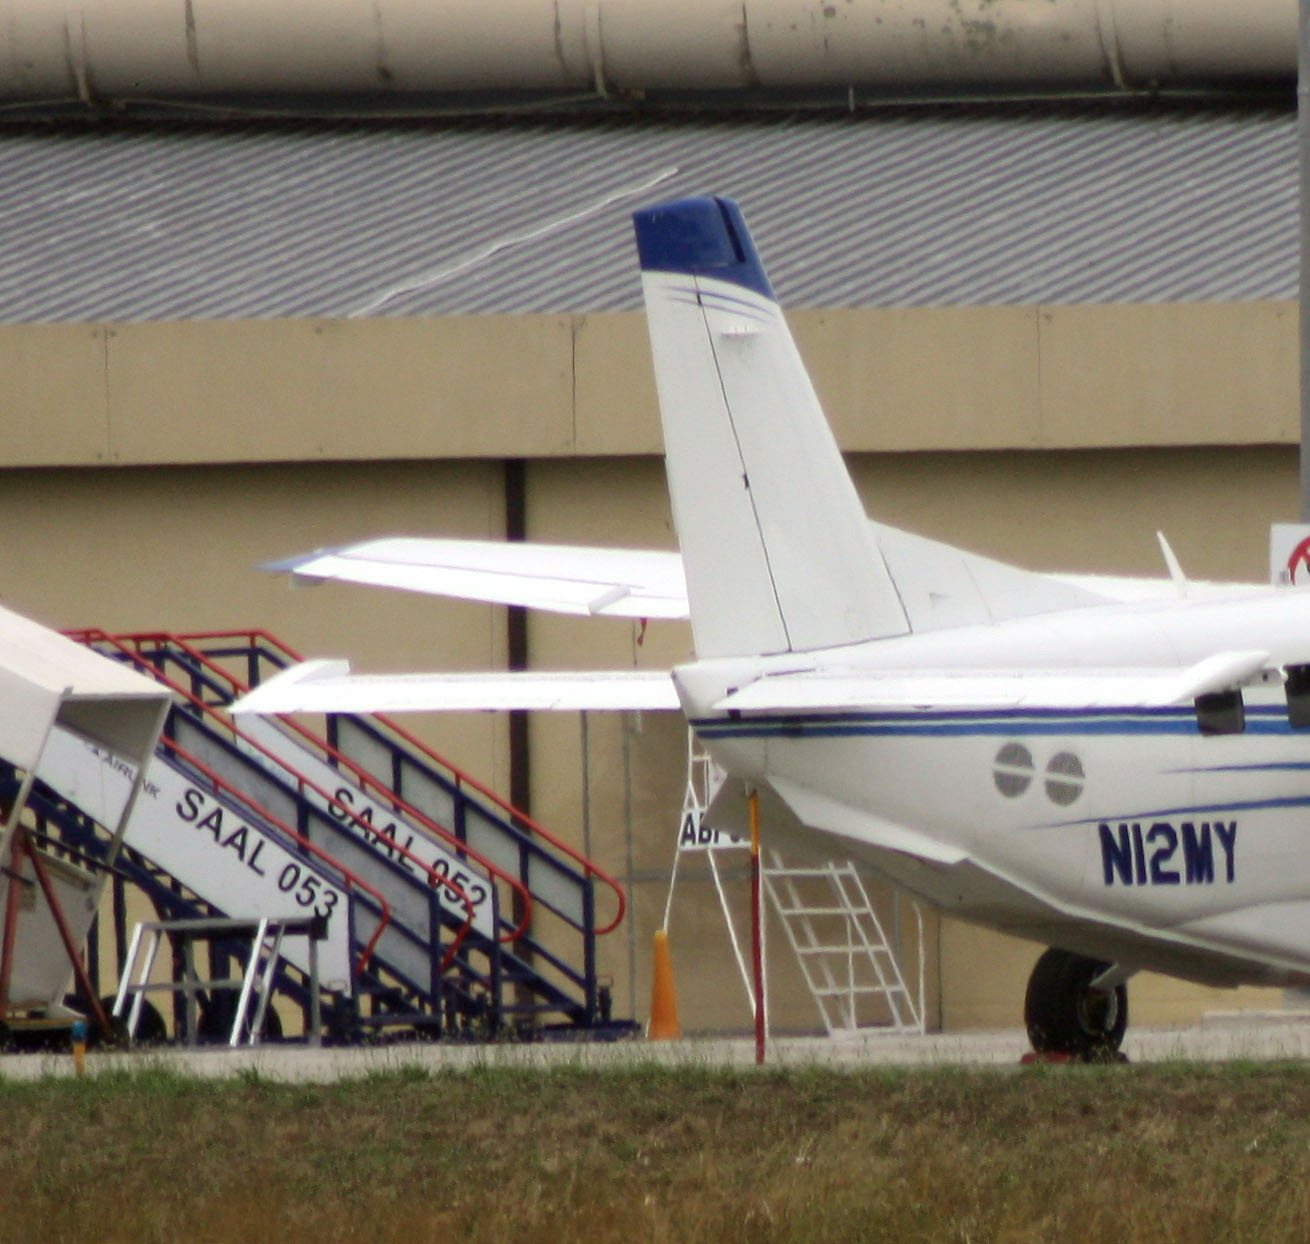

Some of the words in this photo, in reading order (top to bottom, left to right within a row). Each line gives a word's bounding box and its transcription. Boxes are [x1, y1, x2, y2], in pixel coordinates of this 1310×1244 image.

[176, 788, 265, 877] SAAL
[278, 862, 338, 919] 053
[328, 788, 415, 874] SAAL
[427, 859, 487, 918] 052
[1099, 821, 1237, 886] N12MY
